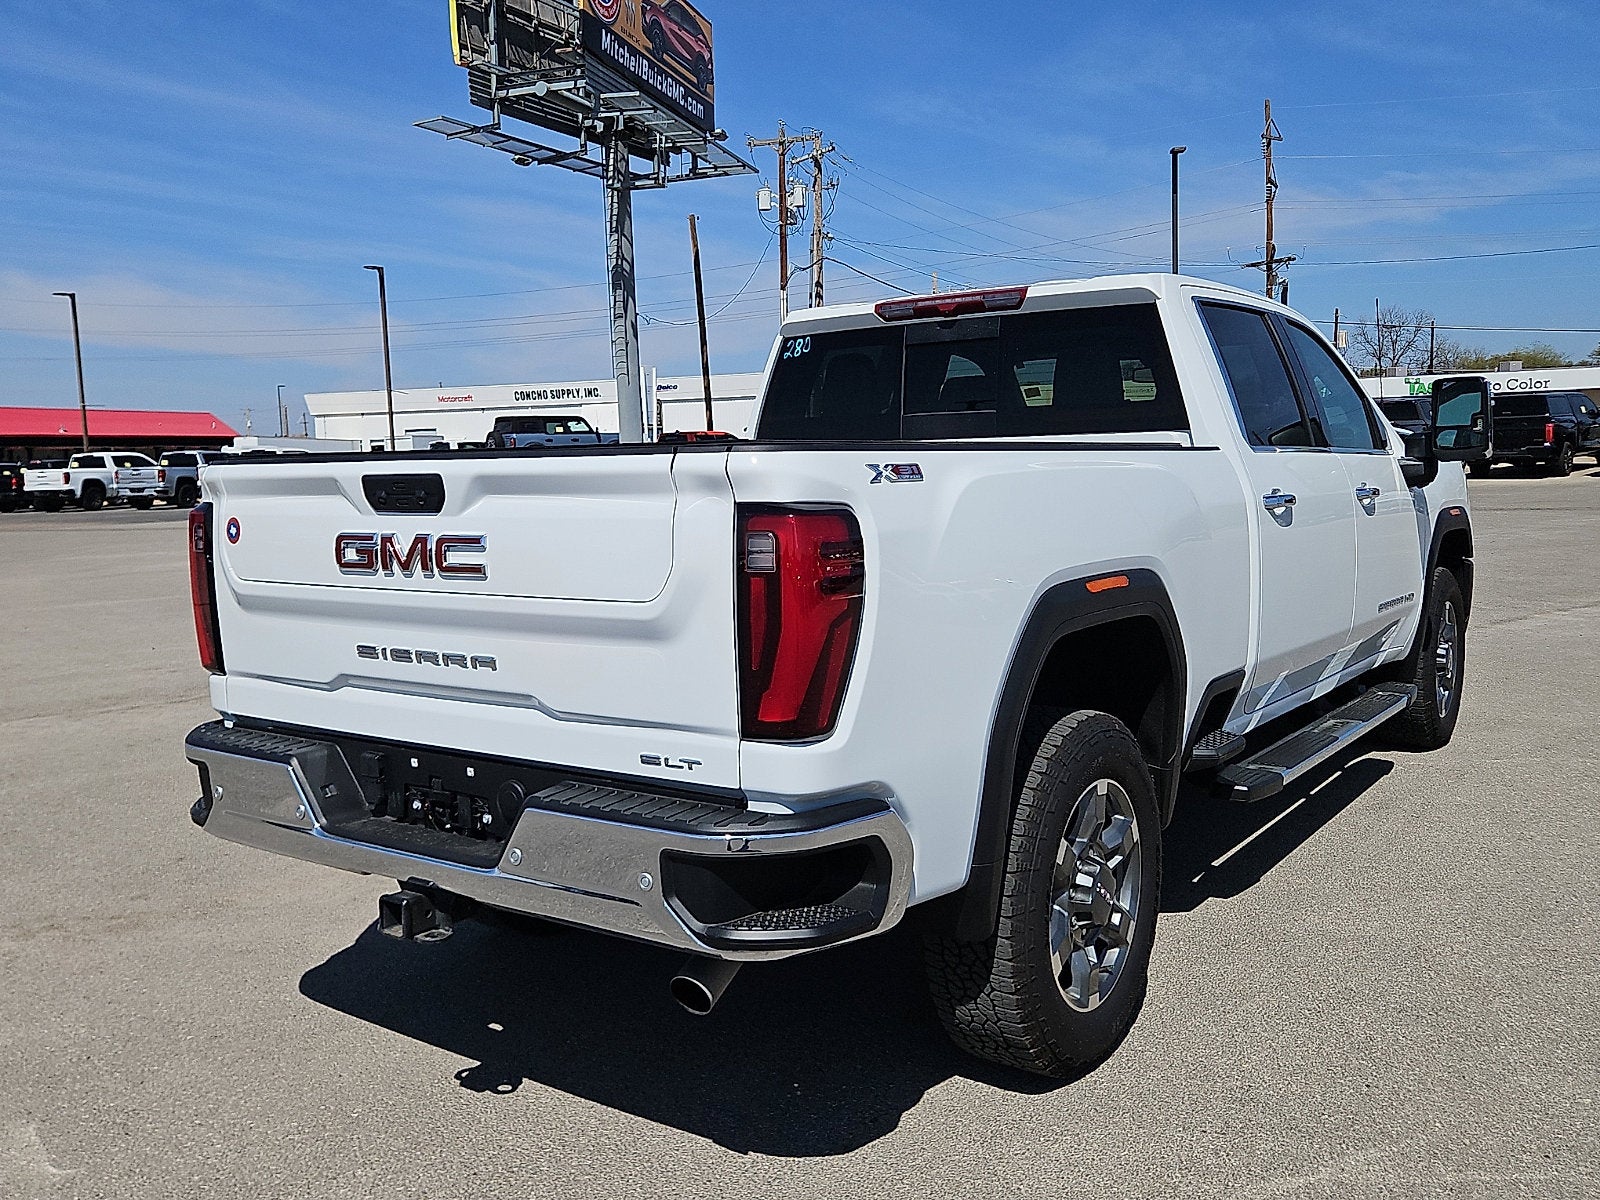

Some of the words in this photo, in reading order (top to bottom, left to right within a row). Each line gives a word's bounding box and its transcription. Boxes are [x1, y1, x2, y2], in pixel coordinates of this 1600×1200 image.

[620, 26, 641, 47] BUICK
[601, 28, 705, 120] MitchellBuickGMC.com
[783, 336, 812, 359] 280
[513, 389, 549, 402] CONCHO
[549, 387, 584, 400] SUPPLY,
[583, 387, 602, 398] INC.
[1506, 377, 1551, 391] Color
[437, 394, 474, 403] Motorcraft
[335, 532, 488, 581] GMC
[356, 644, 498, 672] SIERRA
[640, 753, 703, 771] SLT
